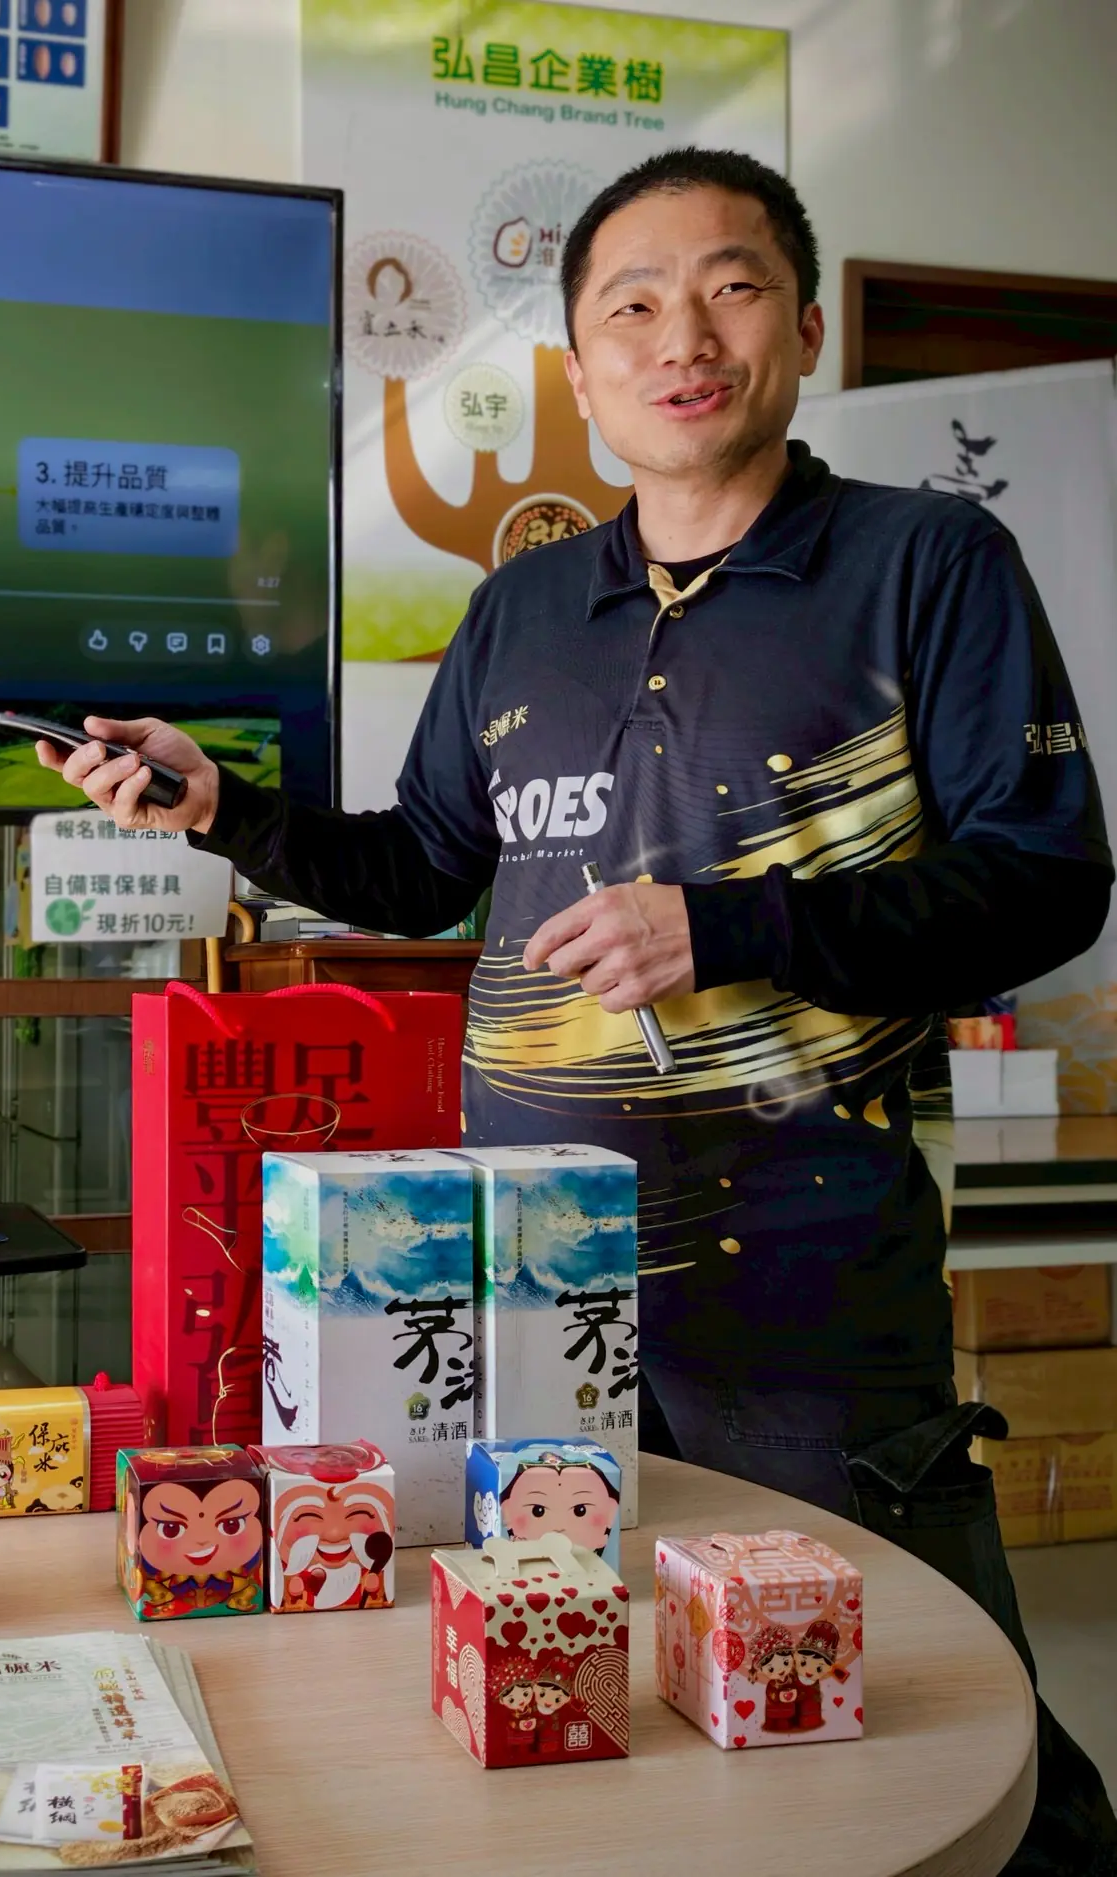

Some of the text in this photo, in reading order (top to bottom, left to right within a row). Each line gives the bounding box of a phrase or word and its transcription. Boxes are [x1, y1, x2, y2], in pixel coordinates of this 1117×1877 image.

[432, 36, 664, 104] 弘昌企業樹
[435, 91, 665, 131] Hung Chang Brand Tree
[460, 391, 508, 420] 弘宇
[35, 459, 169, 492] 3. 提升品質
[537, 848, 584, 859] Market
[44, 874, 182, 896] 自備環保餐具
[431, 1420, 468, 1442] 清酒
[600, 1409, 634, 1431] 清酒
